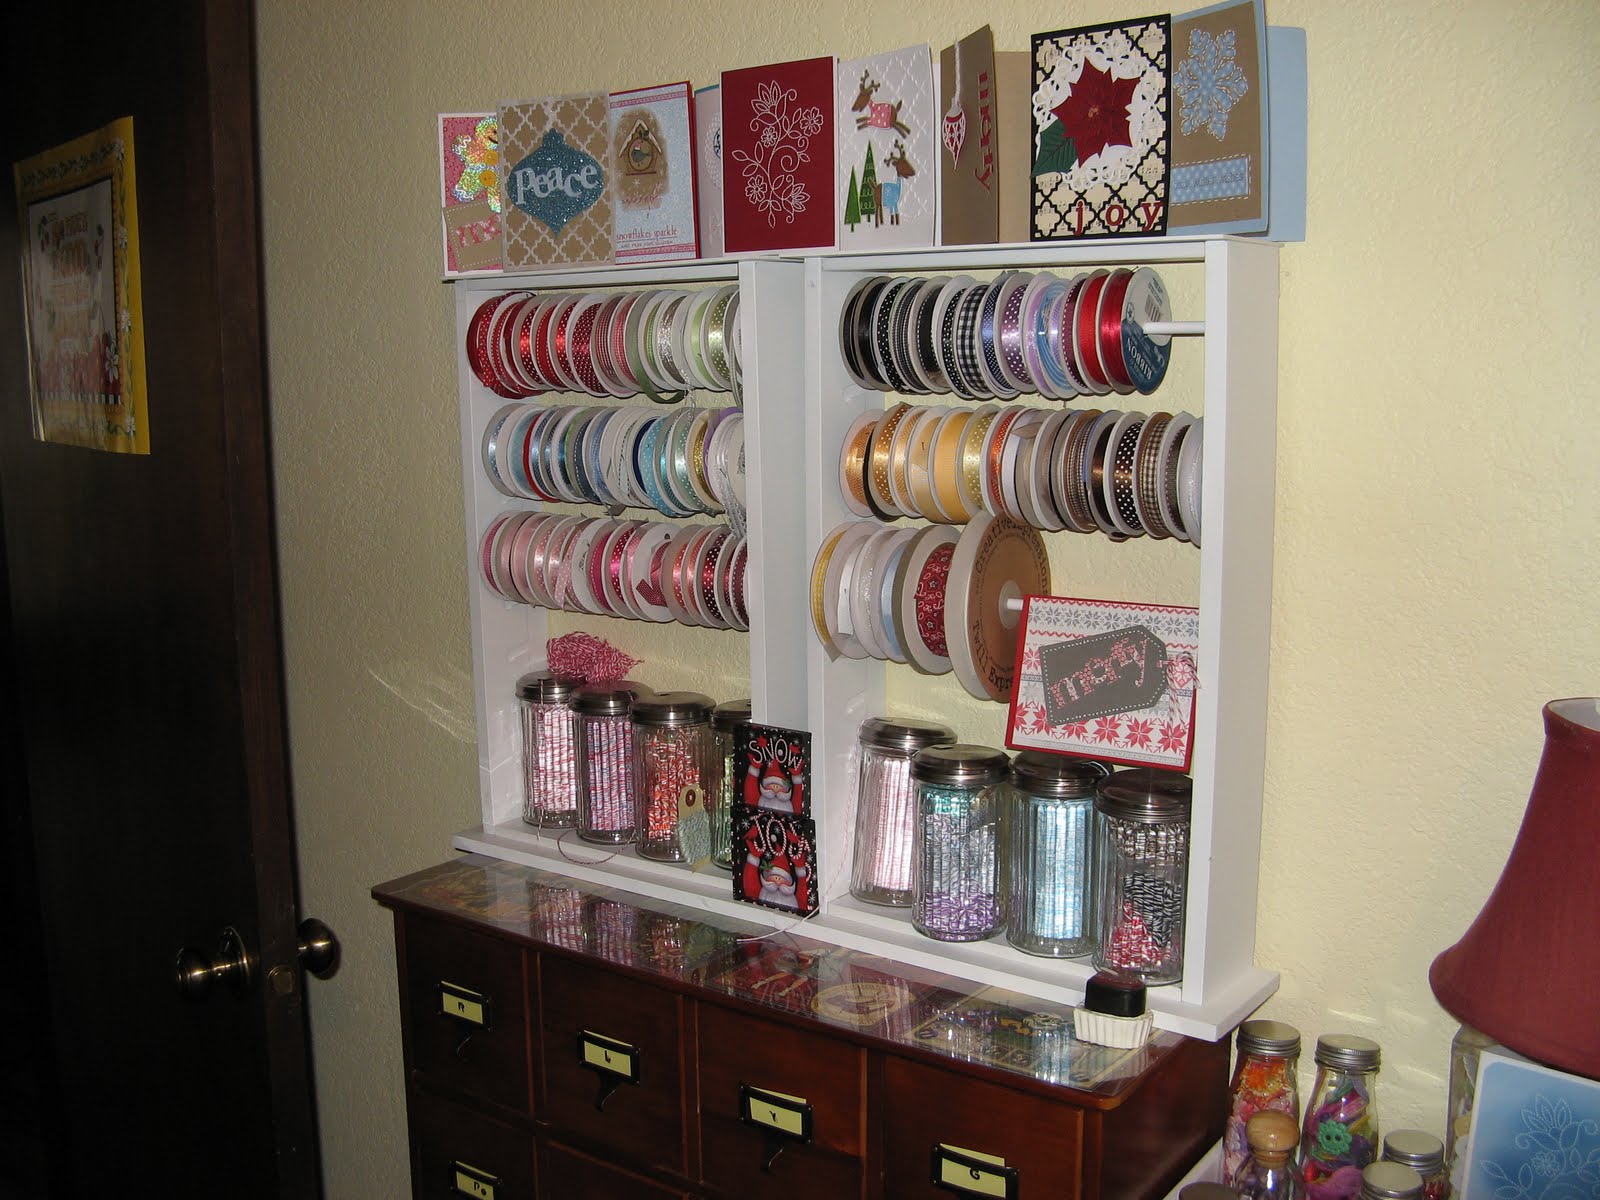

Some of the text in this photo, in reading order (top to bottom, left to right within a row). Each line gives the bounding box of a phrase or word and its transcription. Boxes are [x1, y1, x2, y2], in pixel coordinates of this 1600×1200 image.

[616, 227, 652, 240] snowflakes
[1075, 200, 1164, 236] joy
[972, 620, 989, 673] Twill
[1050, 637, 1149, 710] merry
[969, 1167, 980, 1180] G
